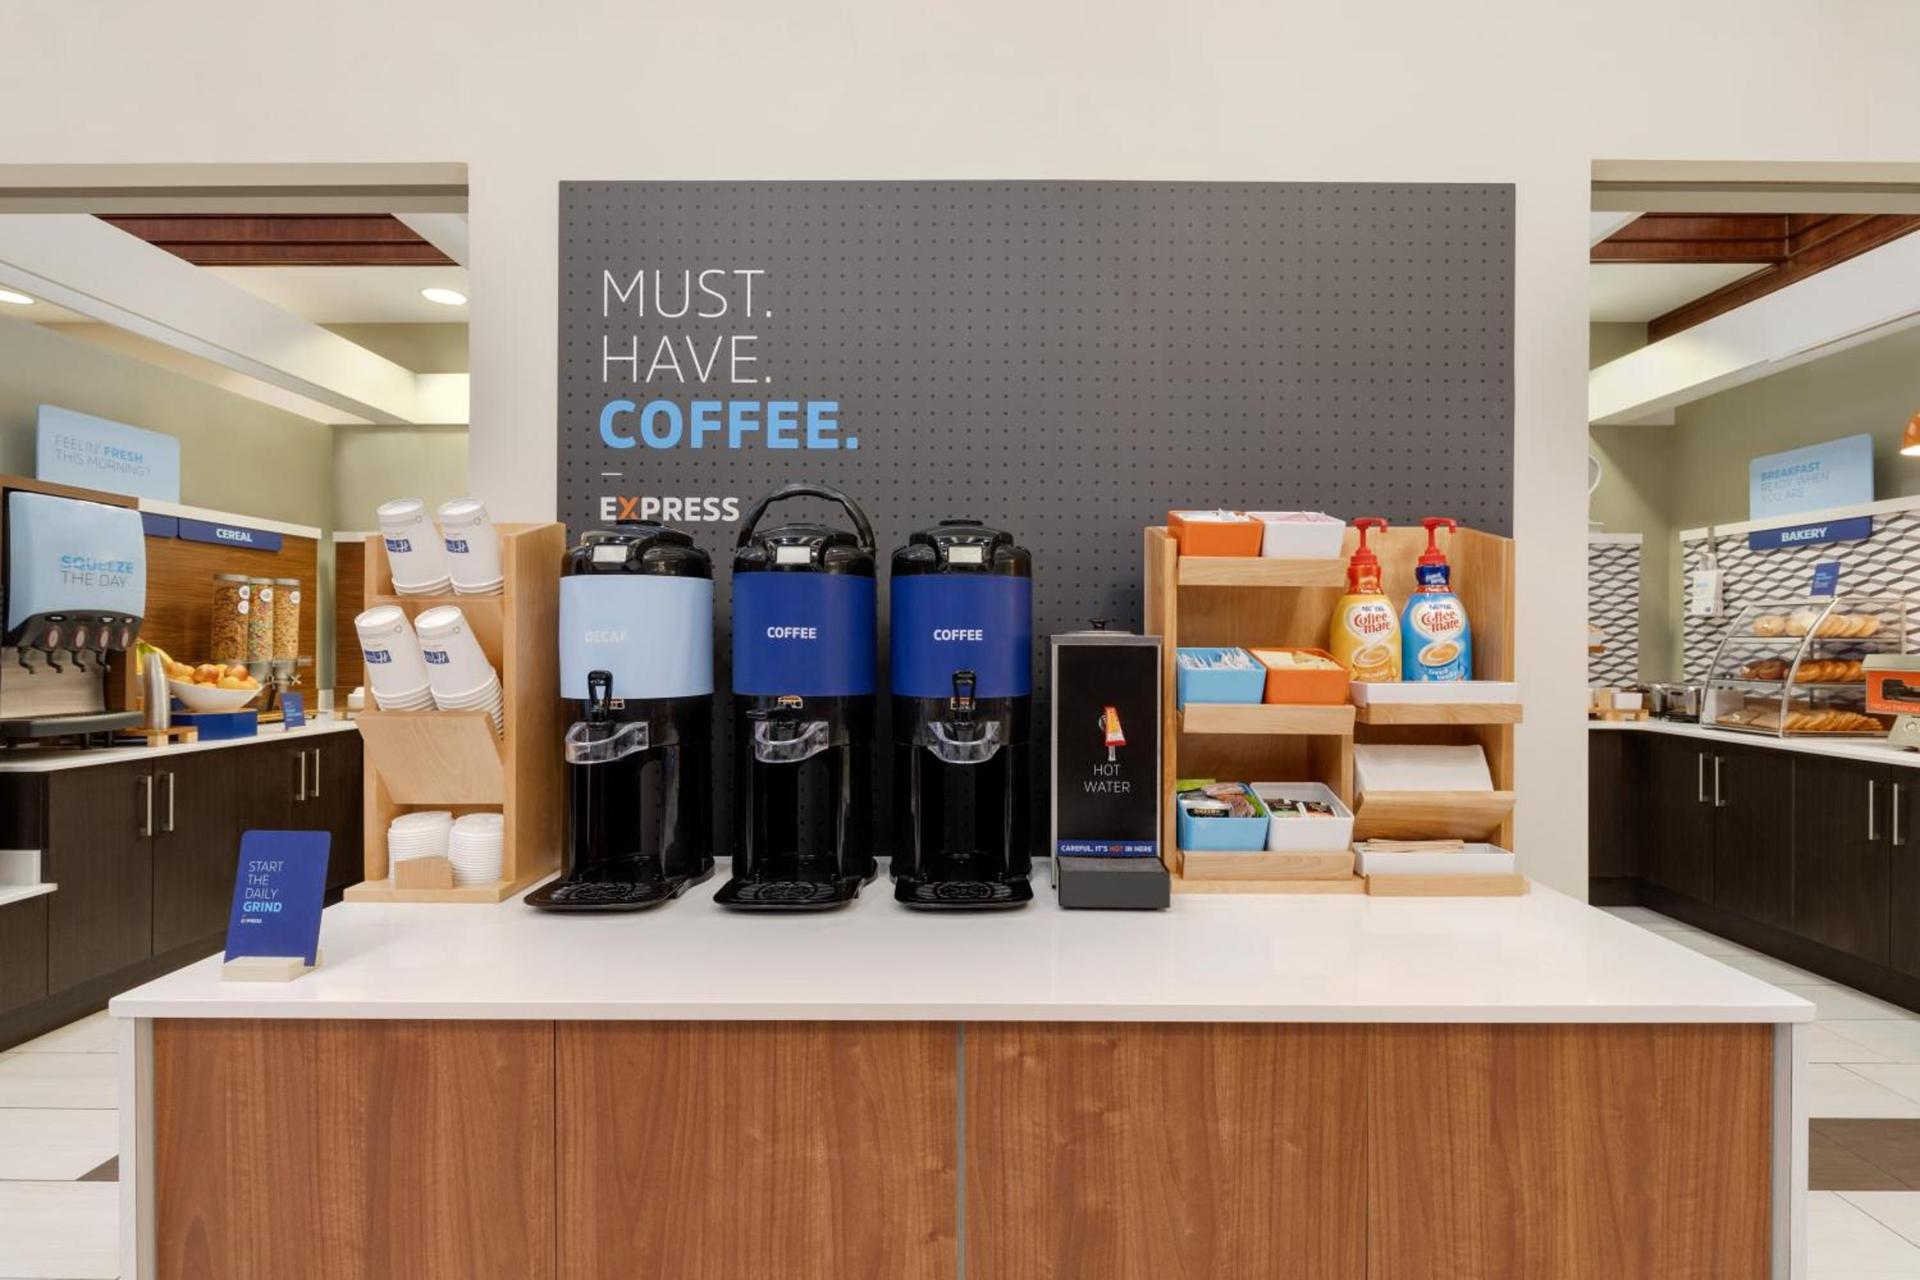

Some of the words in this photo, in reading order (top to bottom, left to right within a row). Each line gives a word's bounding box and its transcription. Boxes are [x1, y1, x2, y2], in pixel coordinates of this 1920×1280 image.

[603, 269, 772, 318] MUST.
[603, 335, 771, 383] HAVE.
[600, 400, 858, 449] COFFEE.
[103, 445, 144, 464] FRESH
[1760, 461, 1822, 482] BREAKFAST
[600, 496, 740, 521] EXPRESS
[216, 528, 253, 543] CEREAL
[1781, 526, 1828, 543] BAKERY
[61, 555, 134, 575] SQUEEZE
[60, 570, 94, 587] THE
[99, 573, 129, 588] DAY
[767, 627, 817, 639] COFFEE
[933, 629, 983, 641] COFFEE
[1093, 764, 1121, 776] HOT
[1083, 781, 1131, 793] WATER
[248, 861, 284, 873] START
[247, 874, 270, 886] THE
[245, 888, 279, 900] DAILY
[243, 901, 283, 913] GRIND
